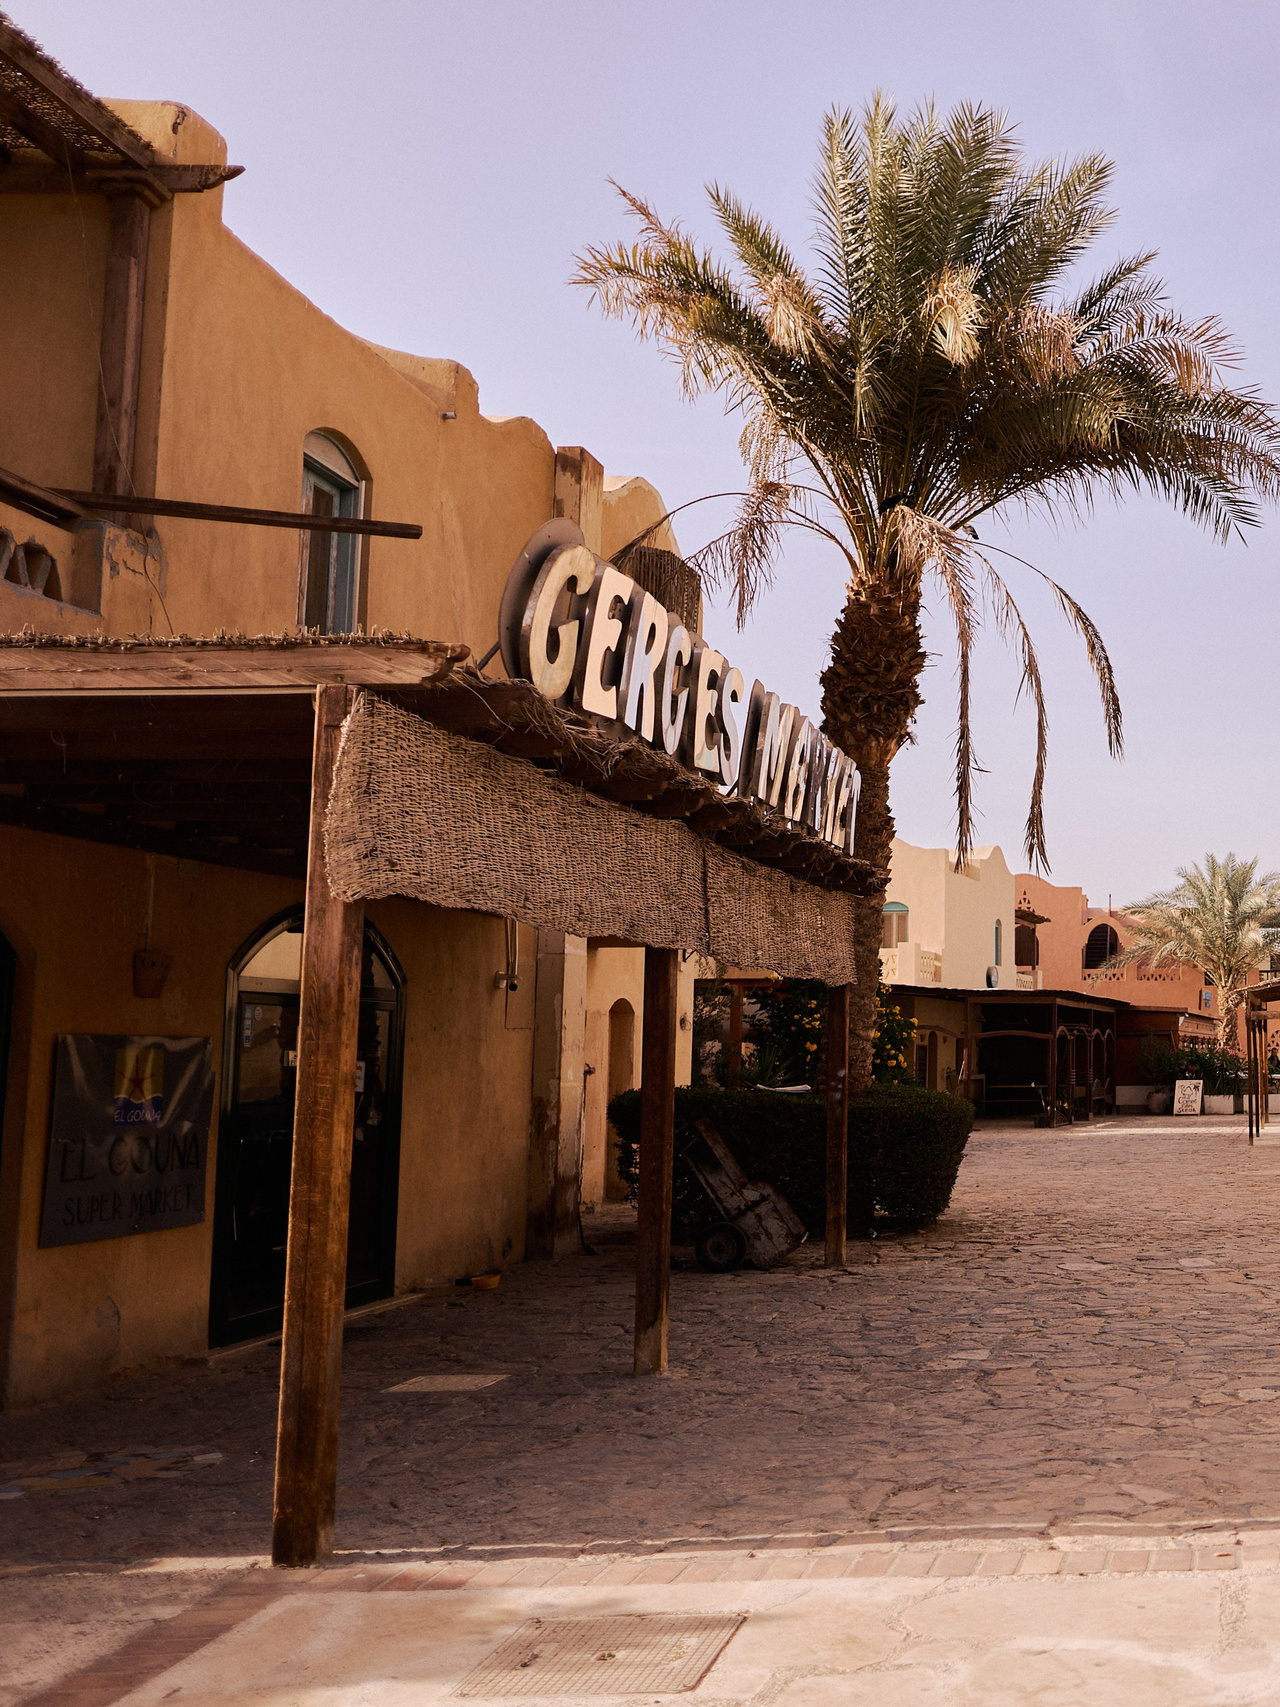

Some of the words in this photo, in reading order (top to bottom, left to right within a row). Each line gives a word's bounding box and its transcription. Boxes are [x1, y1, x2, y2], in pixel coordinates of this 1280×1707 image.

[527, 544, 744, 787] GERGES
[114, 1109, 125, 1122] EL
[127, 1109, 162, 1123] GOUNA
[60, 1139, 97, 1183] EL
[62, 1191, 123, 1226] SUPER
[128, 1182, 195, 1218] MARKET
